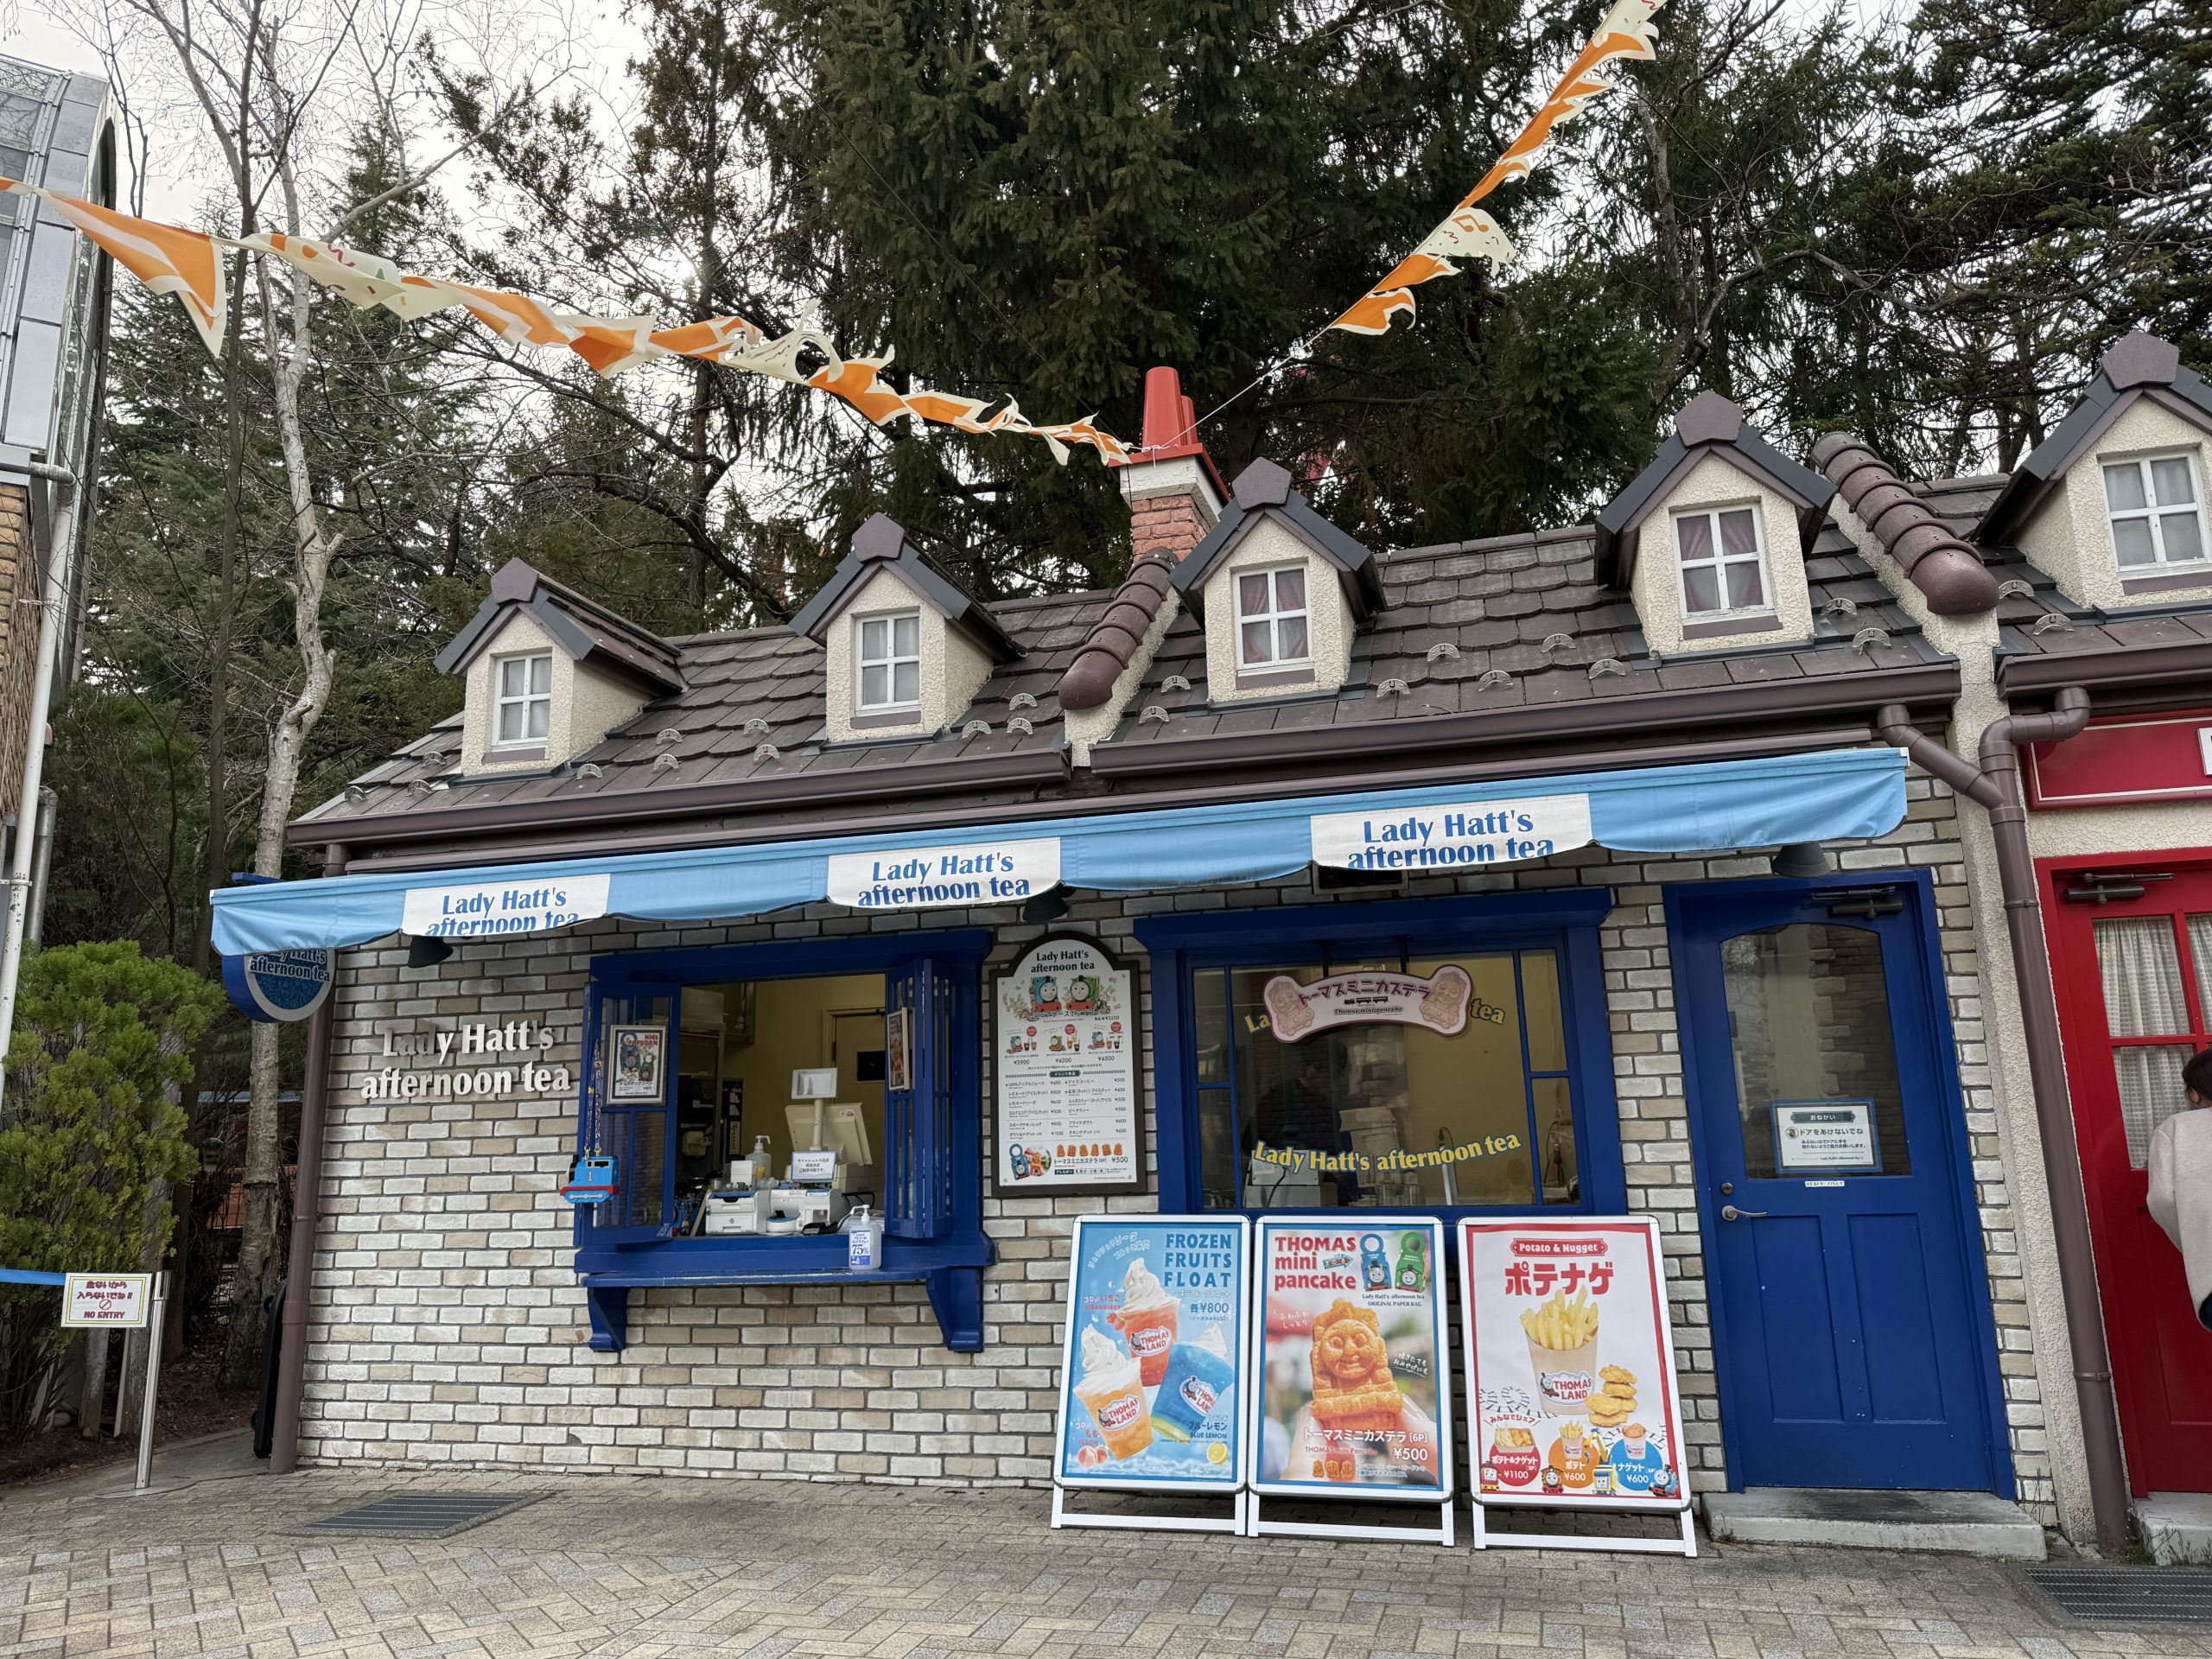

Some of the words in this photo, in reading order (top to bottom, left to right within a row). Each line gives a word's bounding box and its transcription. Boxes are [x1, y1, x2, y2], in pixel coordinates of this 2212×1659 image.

[1363, 817, 1434, 846] Lady
[1445, 810, 1534, 837] Hatt's
[1348, 846, 1495, 869] afternoon
[1506, 837, 1554, 860] tea
[872, 859, 932, 884] Lady
[940, 852, 1014, 876] Hatt's
[857, 881, 981, 906] afternoon
[989, 876, 1030, 897] tea
[442, 893, 495, 918] Lady
[502, 887, 567, 910] Hatt's
[1037, 952, 1058, 963] Lady
[1061, 950, 1089, 960] Hatt's
[249, 956, 311, 980] afternoon
[311, 965, 330, 982] tea
[1031, 963, 1077, 973] afternoon
[1297, 980, 1432, 1006] トーマスミニカステラ
[1470, 997, 1506, 1025] tea
[383, 1023, 454, 1065] Lady
[461, 1020, 555, 1054] Hatt's
[361, 1066, 512, 1098] afternoon
[521, 1060, 571, 1092] tea
[1255, 1140, 1305, 1173] Lady
[1310, 1152, 1370, 1173] Hatt's
[1376, 1138, 1483, 1171] afternoon
[1484, 1133, 1522, 1156] tea
[1166, 1234, 1232, 1249] FROZEN
[1274, 1236, 1356, 1252] THOMAS
[1519, 1243, 1550, 1252] Potato
[1553, 1243, 1560, 1252] &
[1562, 1243, 1598, 1254] Nugget
[1165, 1252, 1232, 1268] FRUITS
[1274, 1251, 1317, 1270] mini
[1164, 1272, 1231, 1287] FLOAT
[1274, 1272, 1356, 1291] pancake
[1505, 1261, 1614, 1296] ポテナゲ
[1190, 1302, 1229, 1313] 各¥800
[1141, 1331, 1169, 1345] THOMAS
[1146, 1340, 1167, 1352] LAND
[1554, 1377, 1592, 1390] THOMAS
[1561, 1389, 1588, 1400] LAND
[1108, 1397, 1139, 1419] THOMAS
[1116, 1408, 1137, 1424] LAND
[1490, 1414, 1536, 1424] みんなでシェア
[1189, 1421, 1228, 1430] ブルーレモン
[1304, 1428, 1406, 1442] トーマスミニカステラ
[1394, 1447, 1428, 1460] ¥500
[1491, 1455, 1538, 1465] ポテト&ナゲット
[1565, 1460, 1586, 1471] ポテト
[1618, 1462, 1645, 1472] ナゲット
[1503, 1470, 1529, 1479] ¥1100
[1564, 1472, 1586, 1481] ¥600
[1626, 1474, 1649, 1484] ¥600
